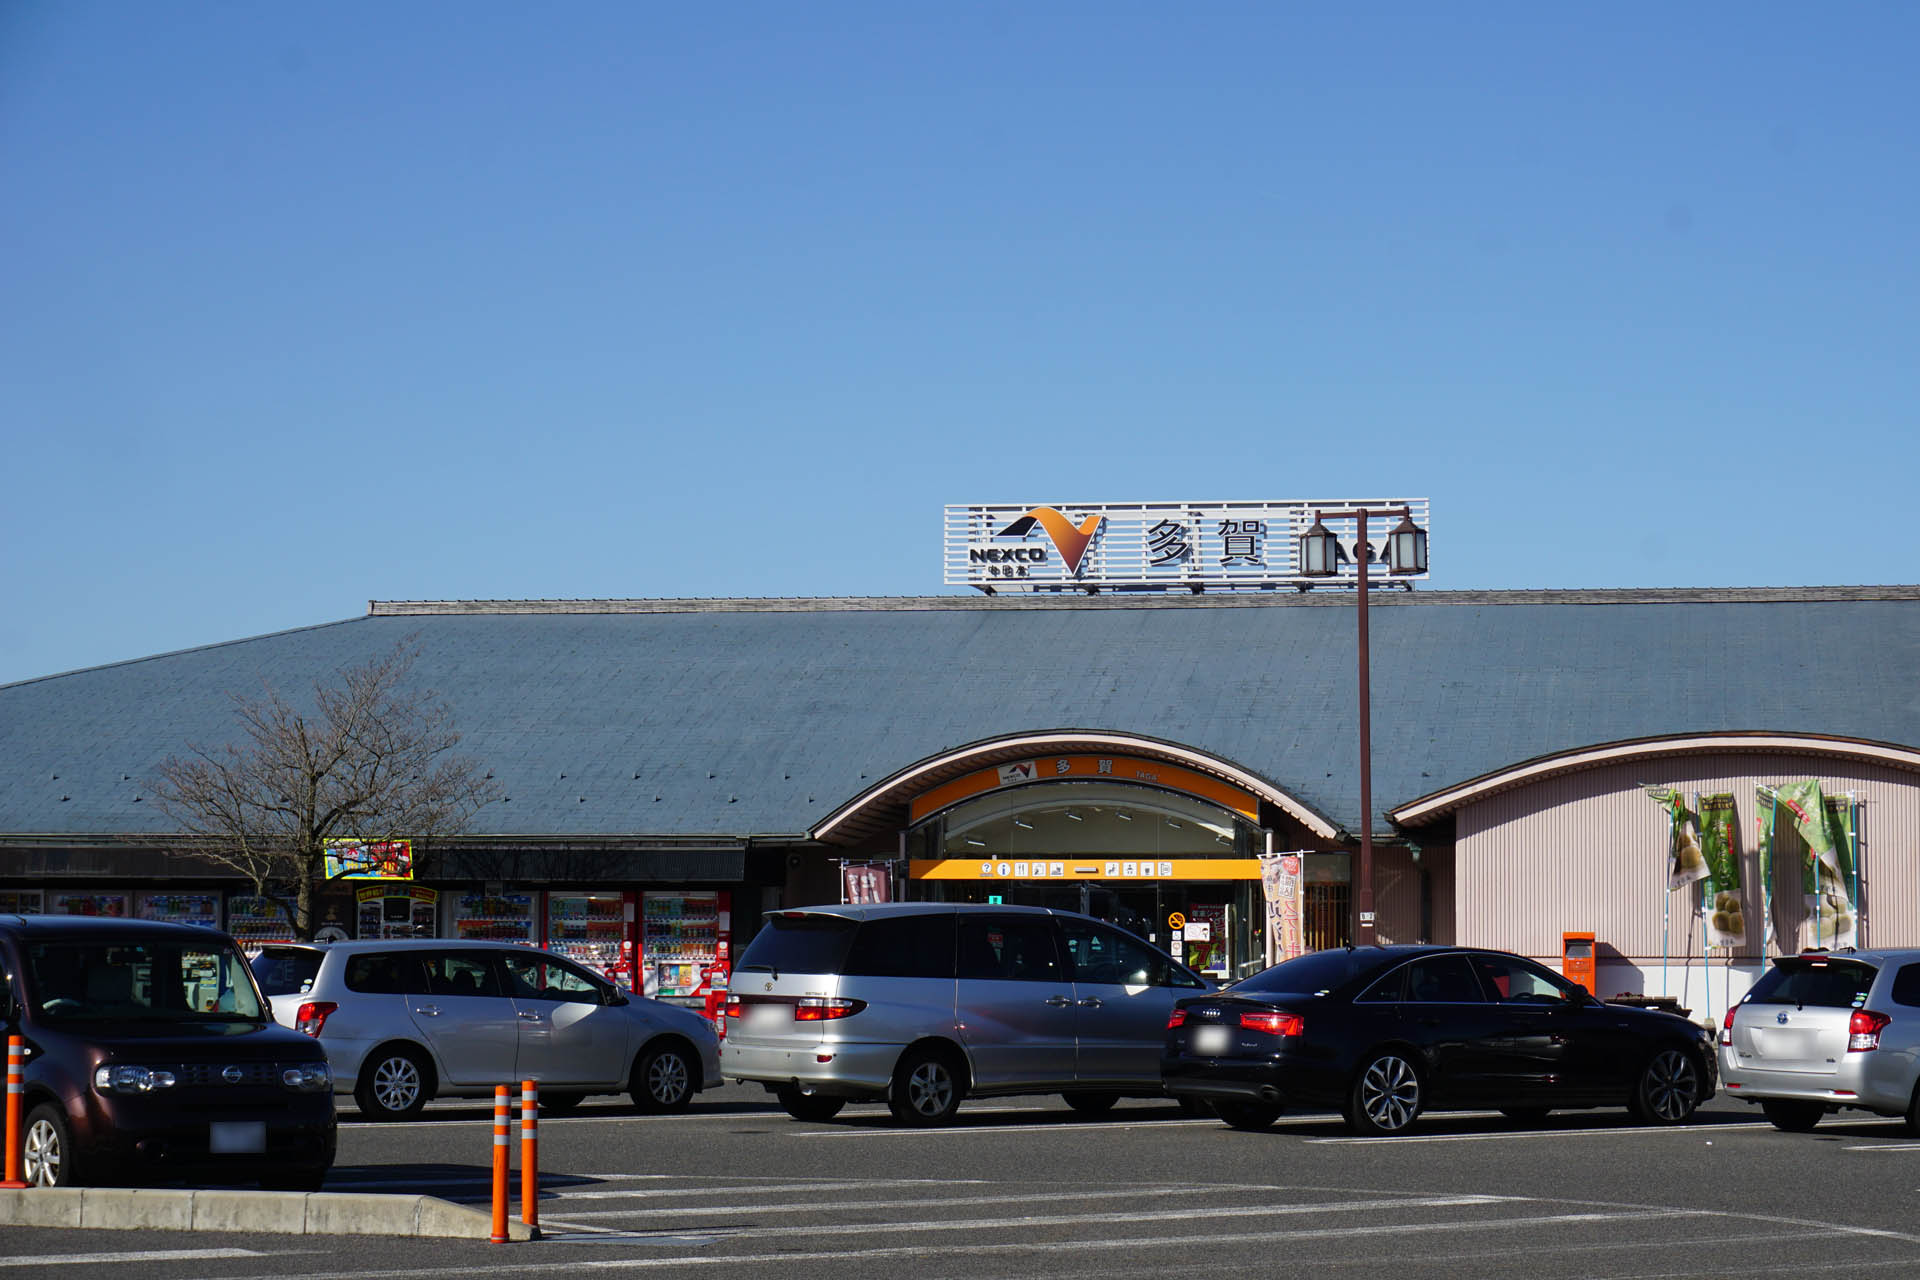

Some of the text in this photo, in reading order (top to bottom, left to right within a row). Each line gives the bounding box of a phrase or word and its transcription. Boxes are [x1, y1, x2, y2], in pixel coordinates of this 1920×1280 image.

[1146, 518, 1262, 567] 多賀
[970, 548, 1046, 563] NEXCO
[1056, 759, 1113, 775] 多賀
